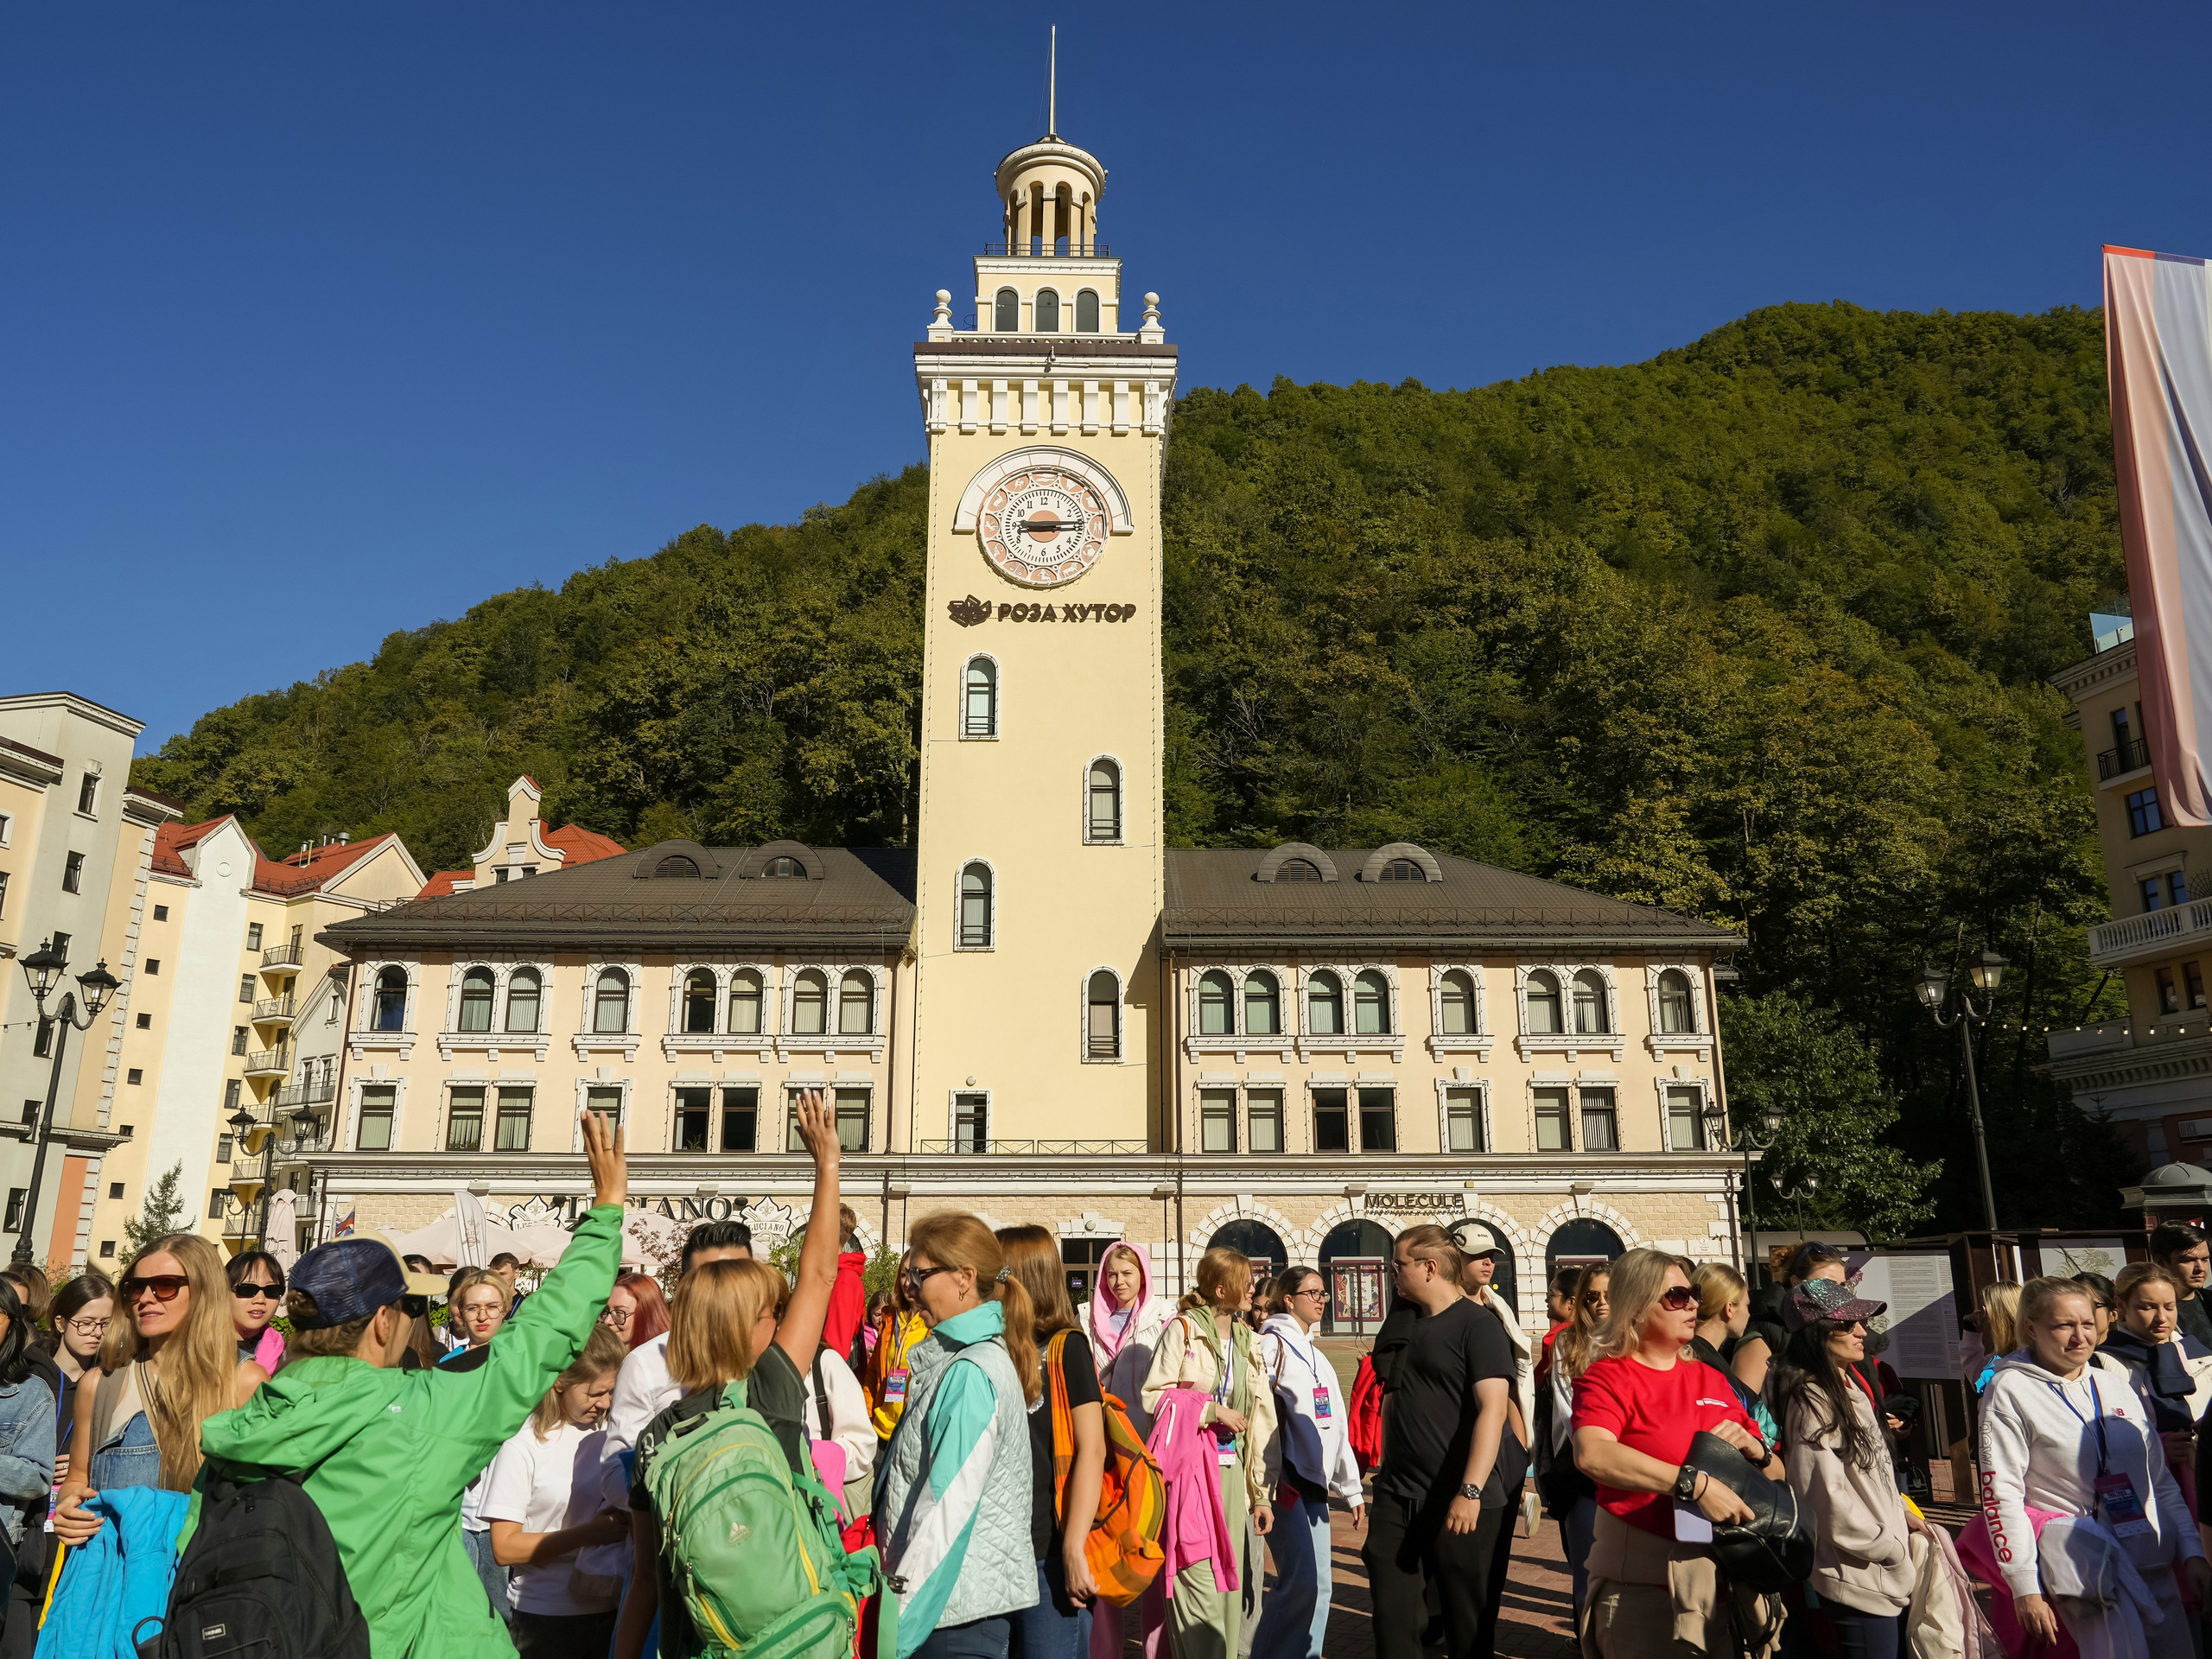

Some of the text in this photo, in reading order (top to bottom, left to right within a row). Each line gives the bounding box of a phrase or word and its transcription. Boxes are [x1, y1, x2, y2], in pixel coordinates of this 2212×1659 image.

[1040, 548, 1046, 556] 6
[997, 603, 1136, 623] РОЗА ХУТОР
[1365, 1193, 1464, 1207] MOLECULE
[749, 1224, 785, 1232] LUCIANO
[1980, 1420, 2012, 1563] new balance
